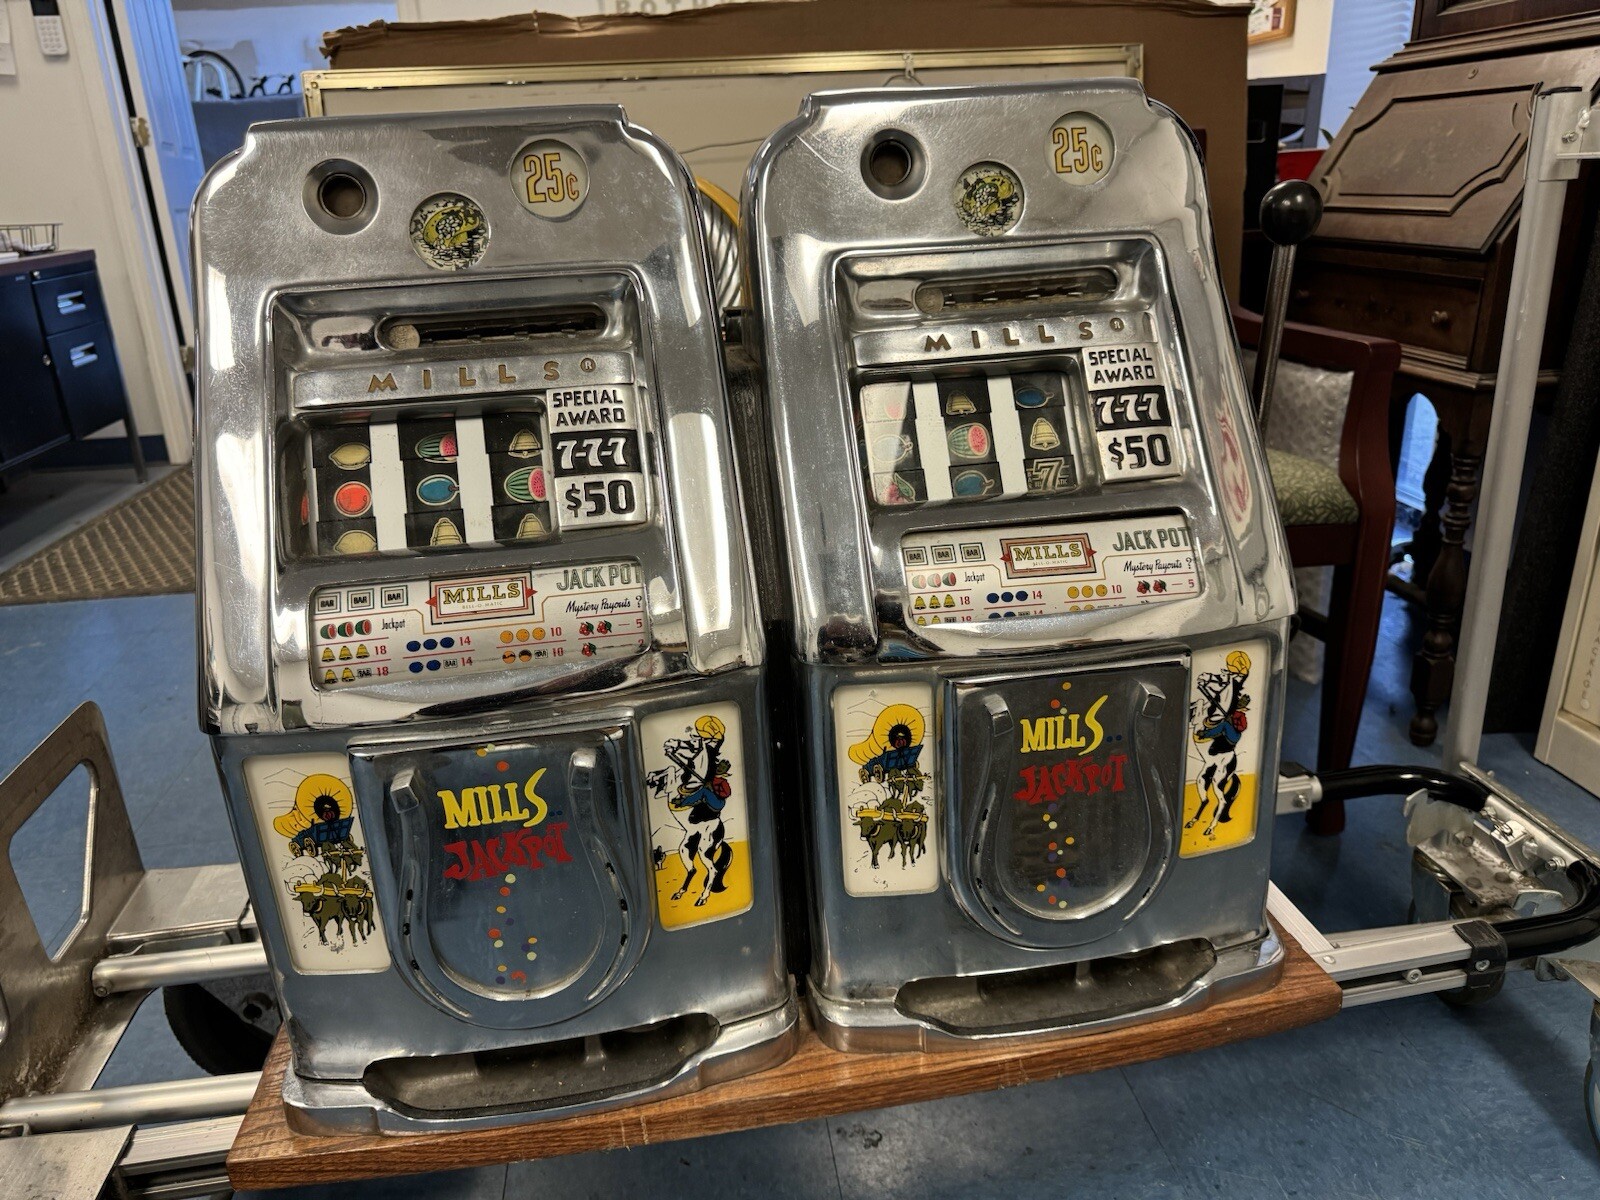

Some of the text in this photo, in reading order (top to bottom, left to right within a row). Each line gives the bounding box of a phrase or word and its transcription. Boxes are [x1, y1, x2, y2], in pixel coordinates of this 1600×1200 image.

[1052, 127, 1103, 174] 25¢
[523, 153, 579, 203] 25¢
[1088, 347, 1153, 367] SPECIAL
[1093, 364, 1156, 385] AWARD
[552, 389, 624, 409] SPECIAL
[1096, 392, 1162, 425] 7-7-7
[556, 407, 627, 427] AWARD
[556, 436, 628, 471] 7-7-7
[1107, 433, 1172, 471] $50
[565, 479, 636, 518] $50
[1013, 543, 1082, 562] MILLS
[1124, 560, 1154, 575] Mystery
[1155, 559, 1182, 574] Payouts
[964, 571, 985, 584] Jackpot
[1188, 579, 1195, 588] 5
[387, 593, 401, 601] BAR
[443, 583, 520, 605] MILLS
[1032, 590, 1042, 600] 14
[1111, 584, 1122, 594] 10
[565, 600, 600, 616] Mystery
[601, 597, 631, 613] Payouts
[960, 596, 971, 605] 18
[381, 618, 406, 631] Jackpot
[550, 627, 562, 637] 10
[635, 619, 642, 628] 5
[374, 645, 387, 655] 18
[459, 636, 471, 646] 14
[461, 657, 473, 666] 14
[552, 647, 563, 657] 10
[376, 666, 388, 676] 18
[1020, 694, 1109, 757] MILLS
[1013, 754, 1129, 805] JACKPOT
[436, 768, 548, 830] MILLS
[443, 822, 573, 882] JACKPOT
